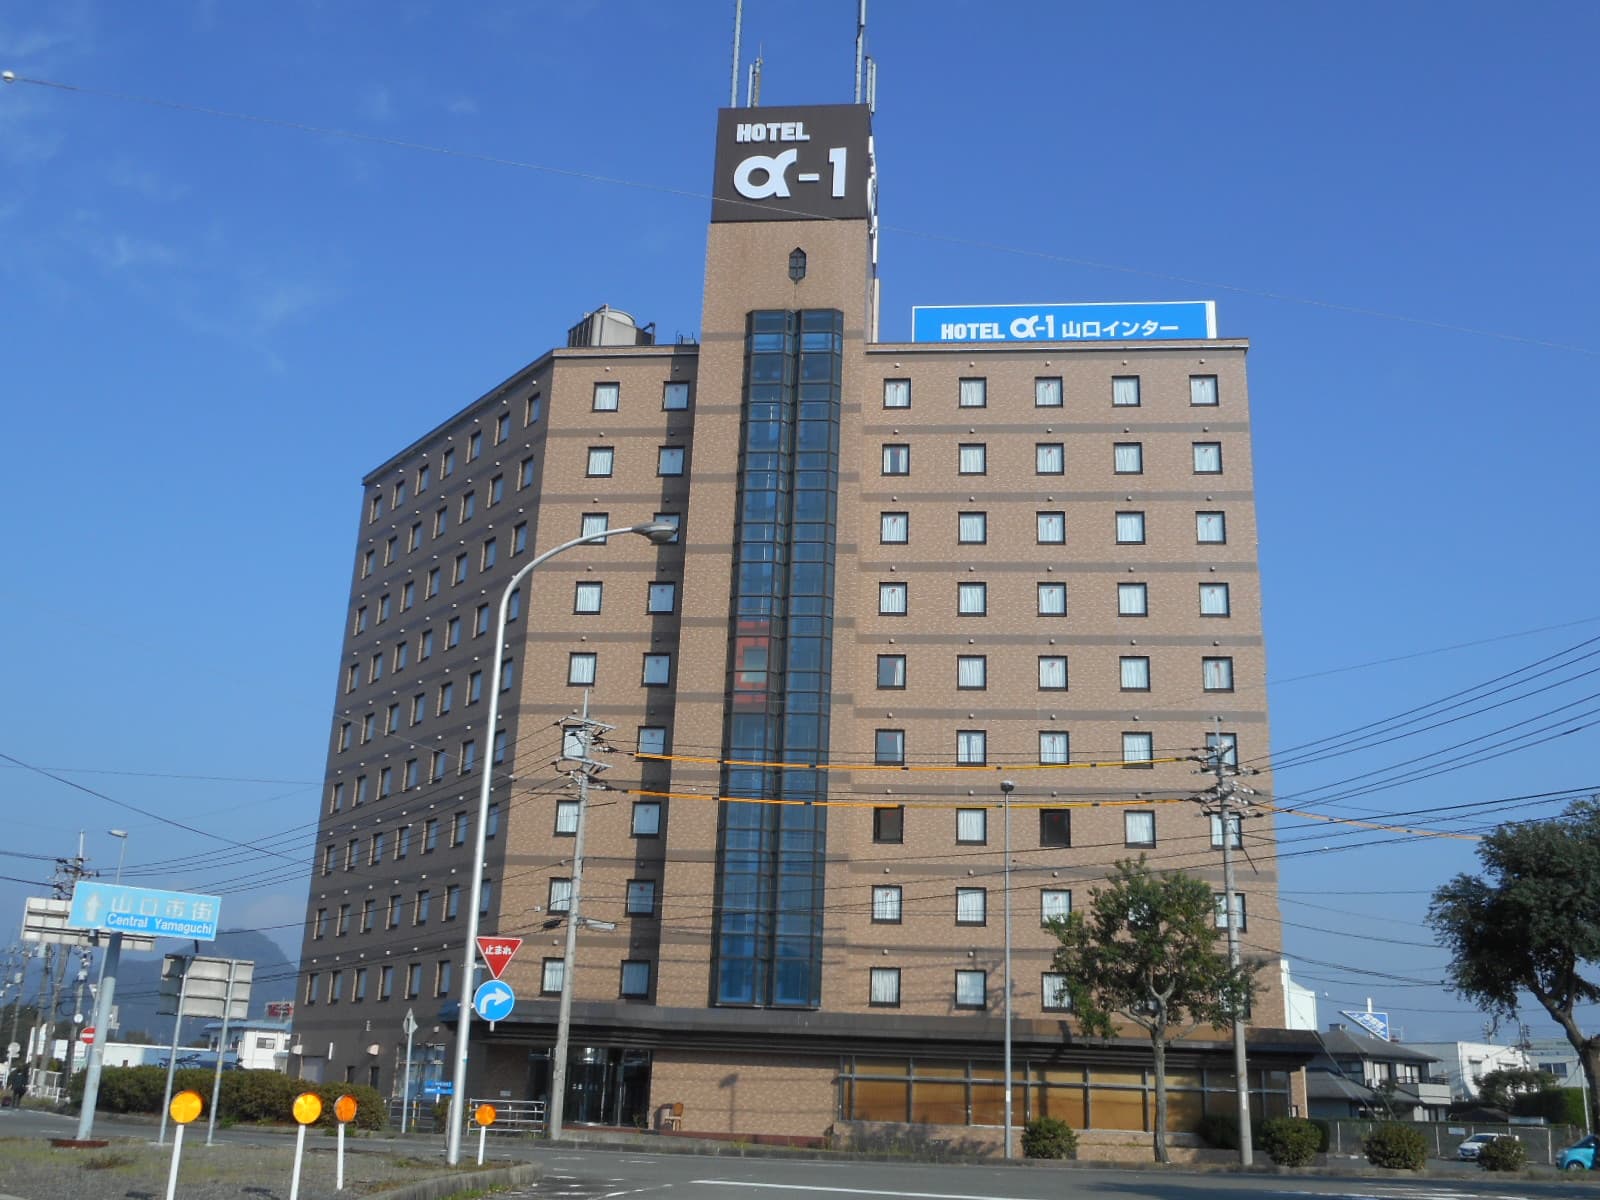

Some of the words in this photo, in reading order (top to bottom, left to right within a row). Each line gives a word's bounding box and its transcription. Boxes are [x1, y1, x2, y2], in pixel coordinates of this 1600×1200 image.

[736, 122, 810, 143] HOTEL
[941, 322, 1005, 340] HOTEL
[1061, 319, 1179, 338] 山口インター
[111, 893, 213, 921] 山口市街
[107, 912, 148, 928] Central
[154, 918, 212, 935] Yamaguchi
[485, 944, 512, 955] 止まれ
